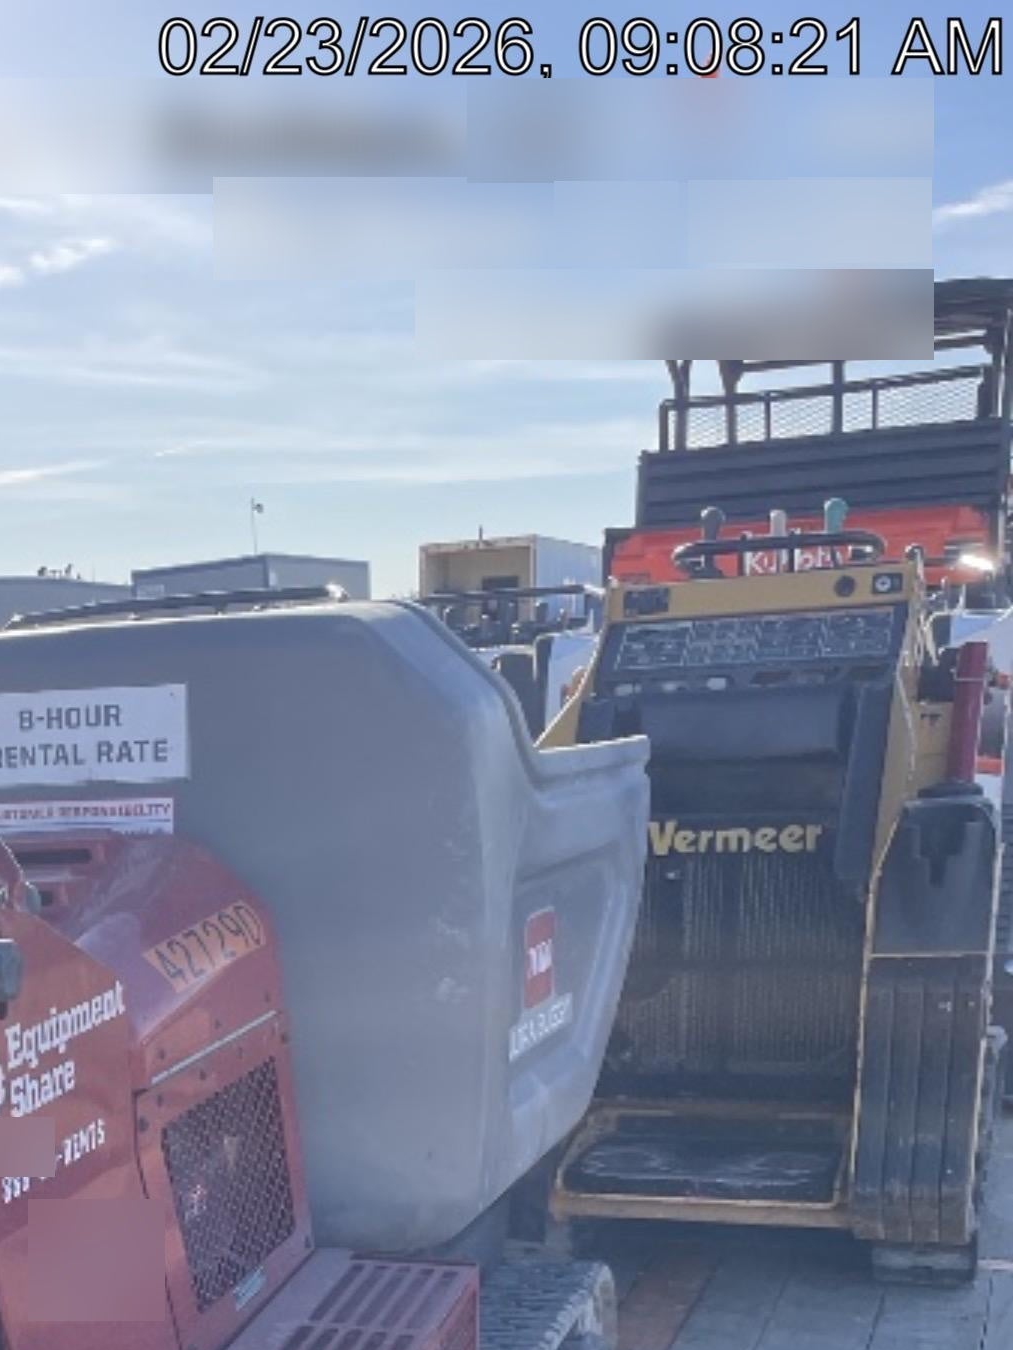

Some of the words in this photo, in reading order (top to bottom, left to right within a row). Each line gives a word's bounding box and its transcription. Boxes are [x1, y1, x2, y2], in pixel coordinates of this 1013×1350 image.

[97, 738, 169, 764] RATE
[648, 819, 823, 856] Vermeer
[4, 979, 127, 1071] Equipment
[9, 1060, 76, 1118] Share
